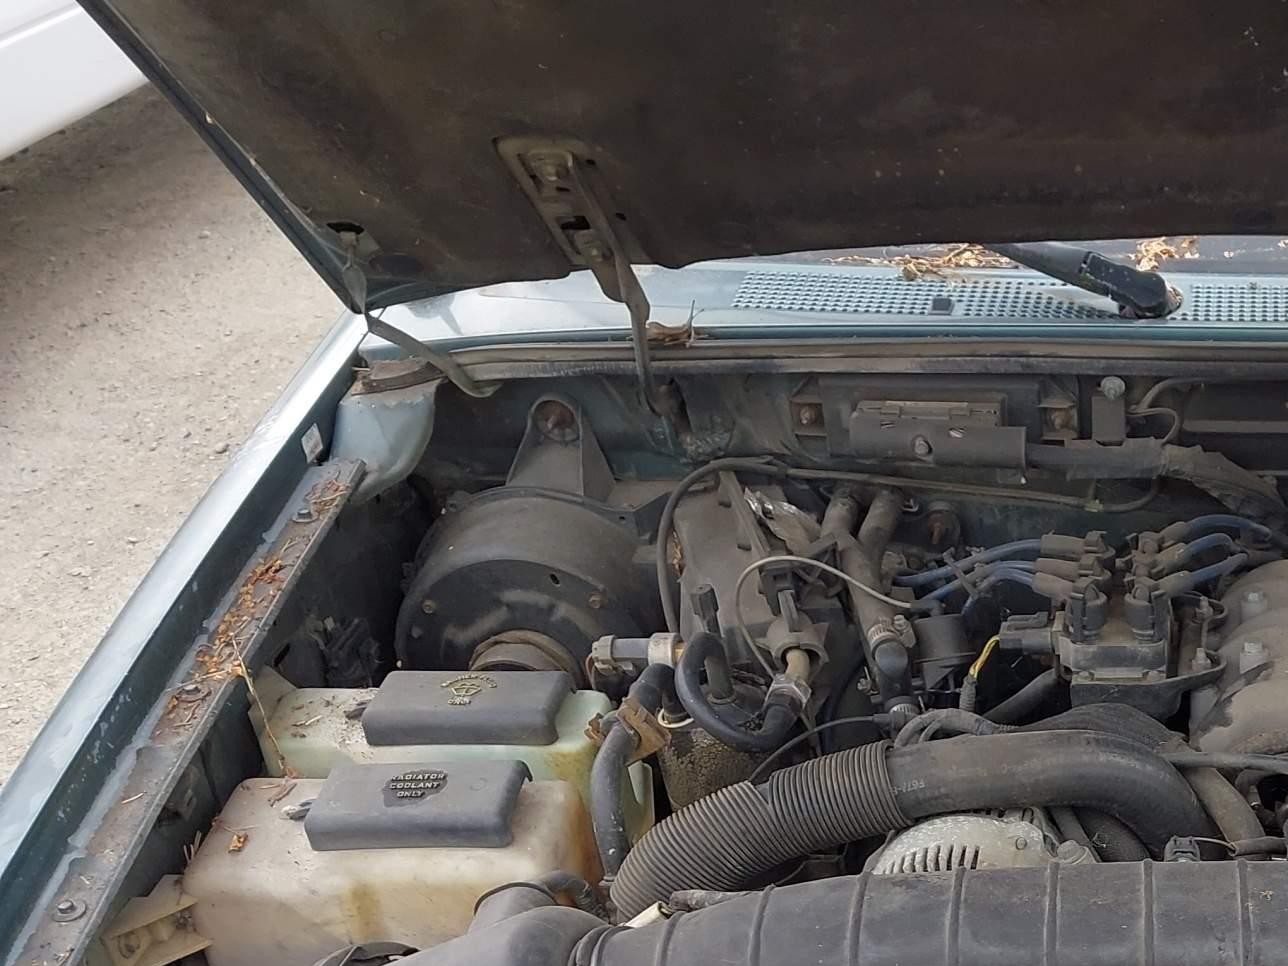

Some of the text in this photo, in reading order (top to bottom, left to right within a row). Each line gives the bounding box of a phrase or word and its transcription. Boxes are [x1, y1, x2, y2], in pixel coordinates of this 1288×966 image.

[390, 772, 446, 782] RADIATOR
[389, 781, 442, 790] COOLANT
[396, 789, 425, 798] ONLY
